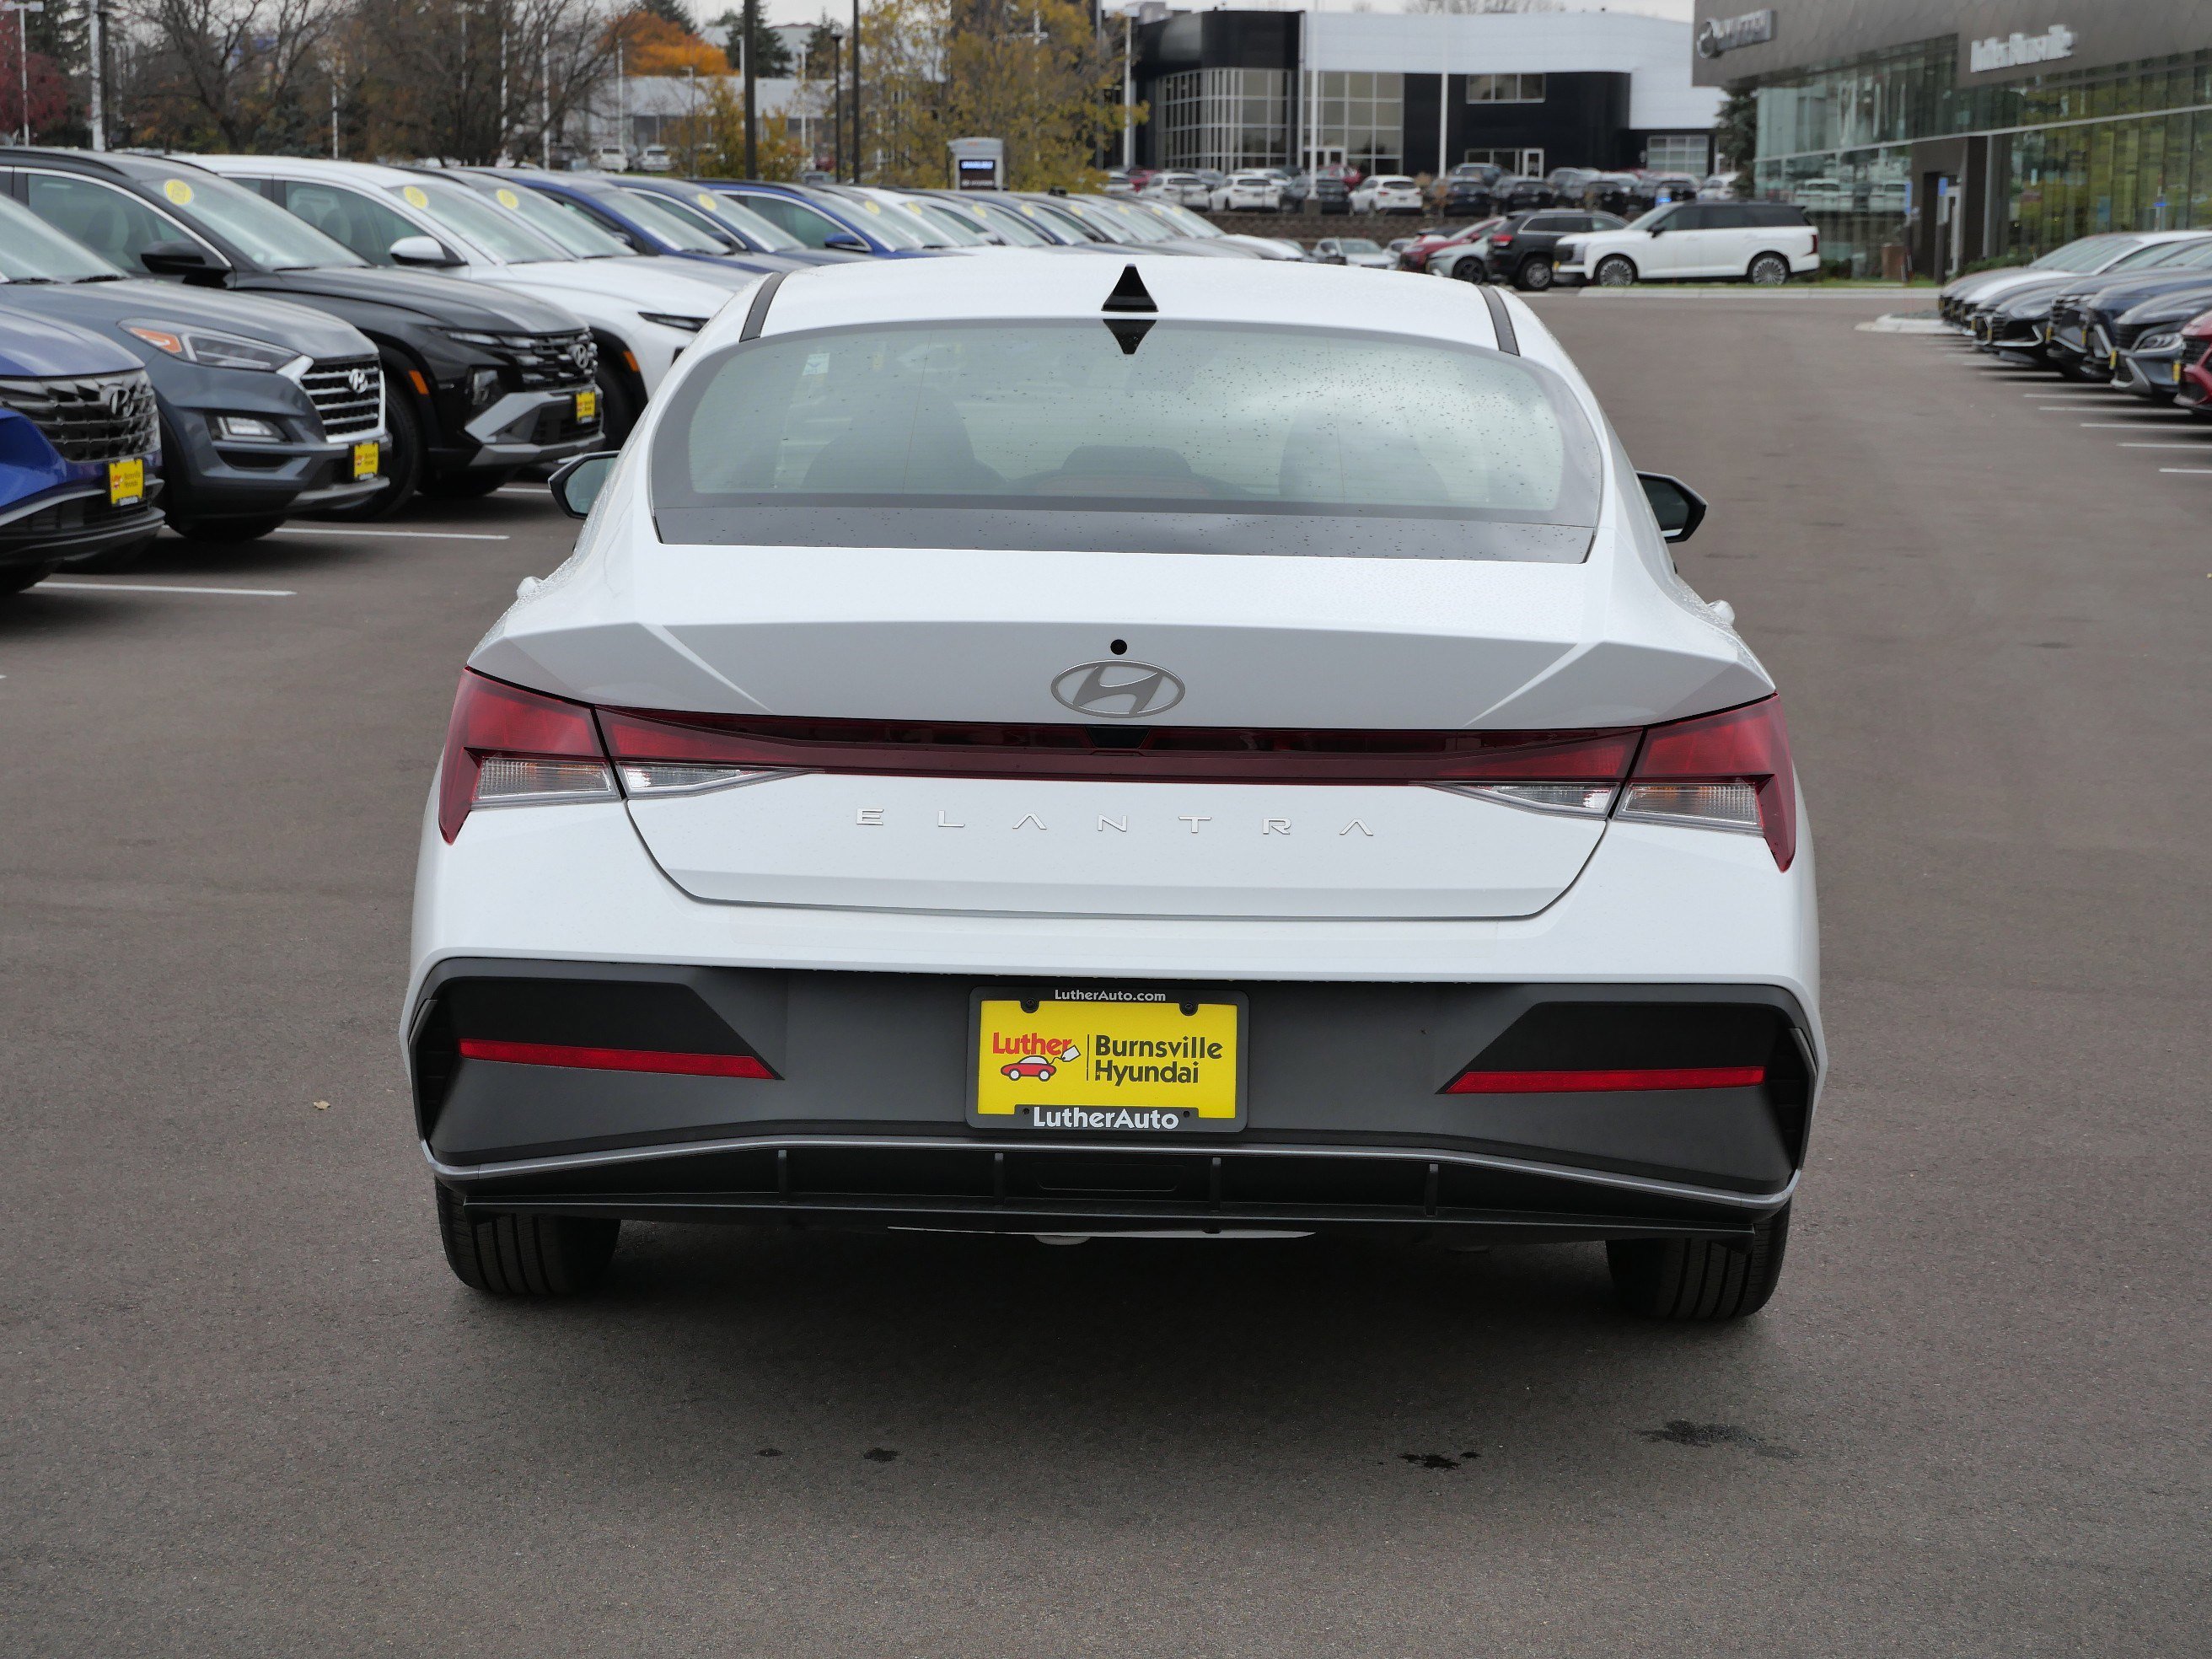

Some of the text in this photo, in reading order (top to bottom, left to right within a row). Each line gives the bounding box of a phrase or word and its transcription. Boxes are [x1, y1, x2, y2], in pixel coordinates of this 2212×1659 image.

[856, 808, 1374, 836] ELANTRA
[1055, 989, 1166, 1002] LutherAuto.com
[992, 1032, 1073, 1056] Luther
[1095, 1034, 1223, 1060] Burnsville
[1095, 1060, 1199, 1087] Hyundai
[1034, 1106, 1179, 1130] LutherAuto
